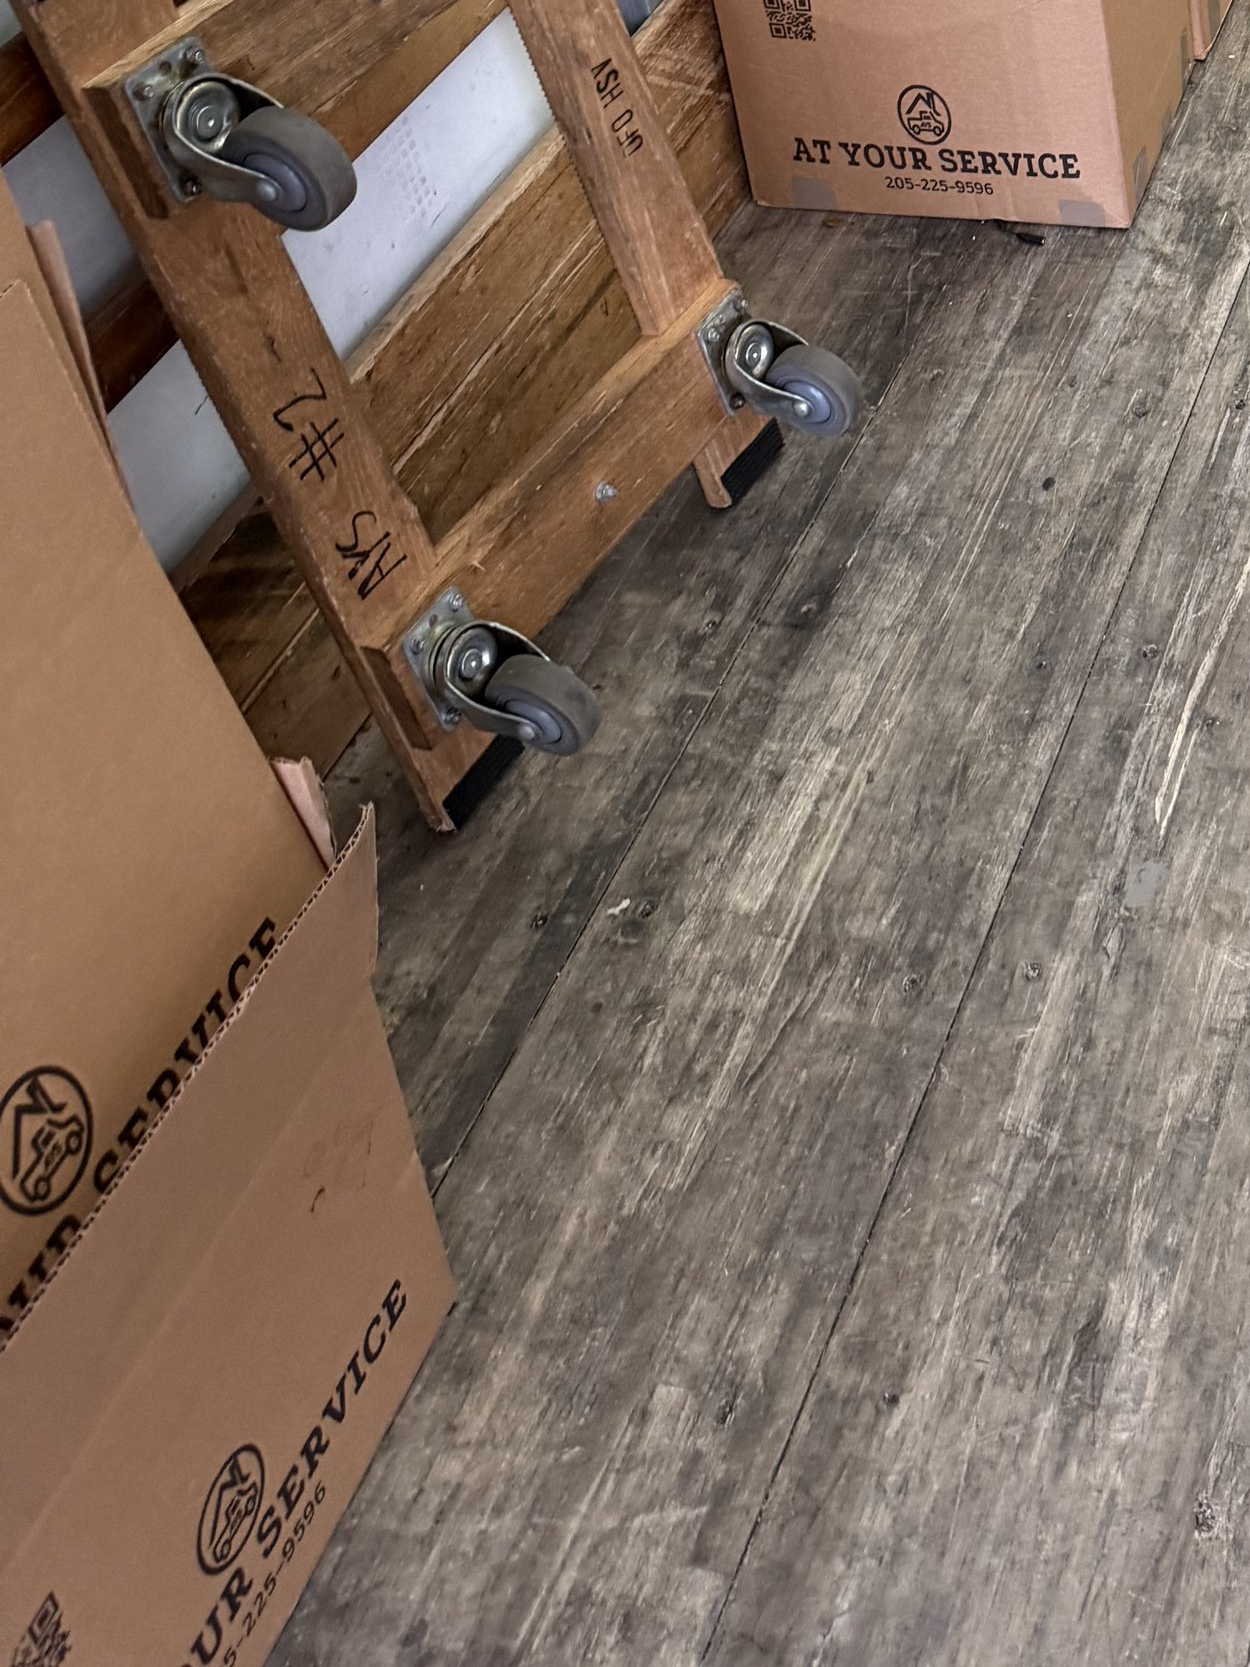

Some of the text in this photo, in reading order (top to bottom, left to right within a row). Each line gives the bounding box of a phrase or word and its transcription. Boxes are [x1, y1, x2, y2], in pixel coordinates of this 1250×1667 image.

[792, 137, 1080, 179] AT YOUR SERVICE
[884, 176, 994, 195] 205-225-9596
[272, 367, 345, 482] #2
[181, 1278, 408, 1667] UR SERVICE
